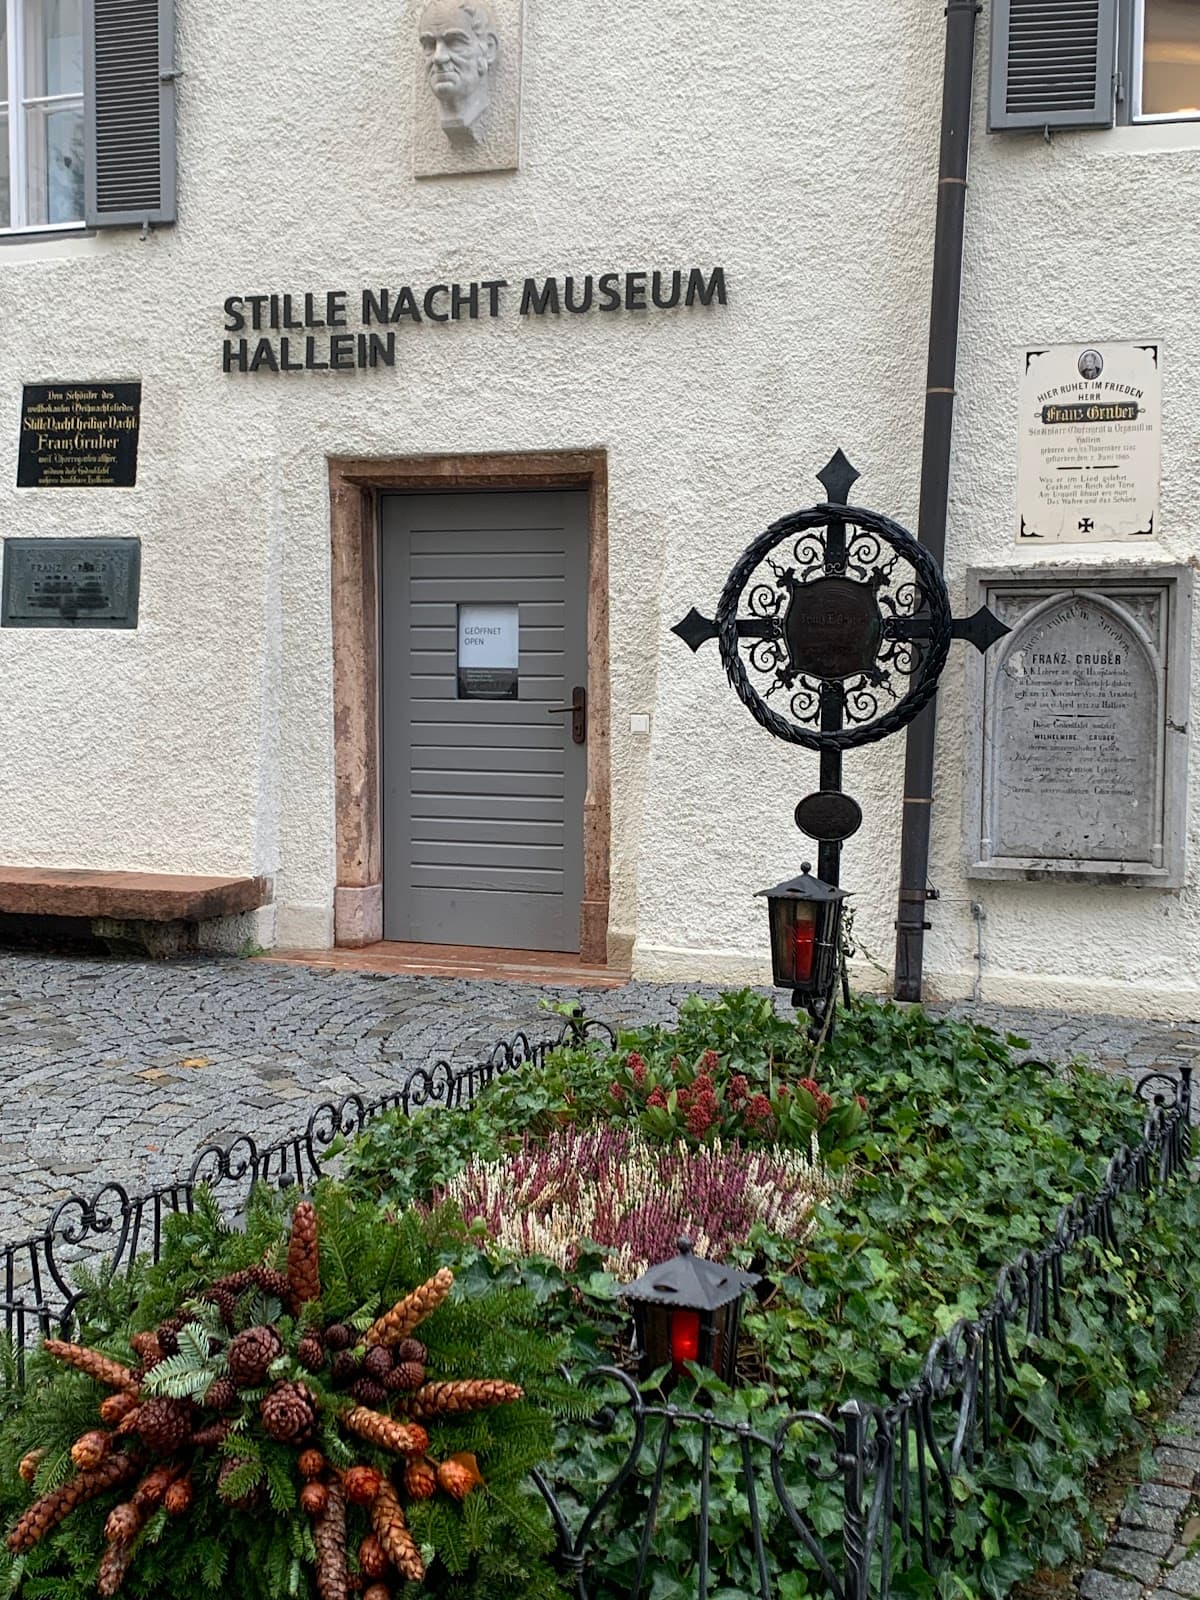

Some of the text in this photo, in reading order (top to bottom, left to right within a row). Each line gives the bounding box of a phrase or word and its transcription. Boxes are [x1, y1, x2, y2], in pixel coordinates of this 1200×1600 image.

[223, 267, 728, 332] STILLE NACHT MUSEUM
[222, 332, 395, 373] HALLEIN
[1037, 381, 1144, 402] HIER RUHET IM FRIEDEN
[1078, 393, 1101, 401] HERR
[1047, 404, 1135, 422] Franz Gruber
[31, 432, 119, 453] Franz Gruber
[31, 564, 62, 573] FRANZ
[464, 626, 502, 635] GEÖFFNET
[464, 638, 485, 646] OPEN
[1032, 654, 1067, 665] FRANZ
